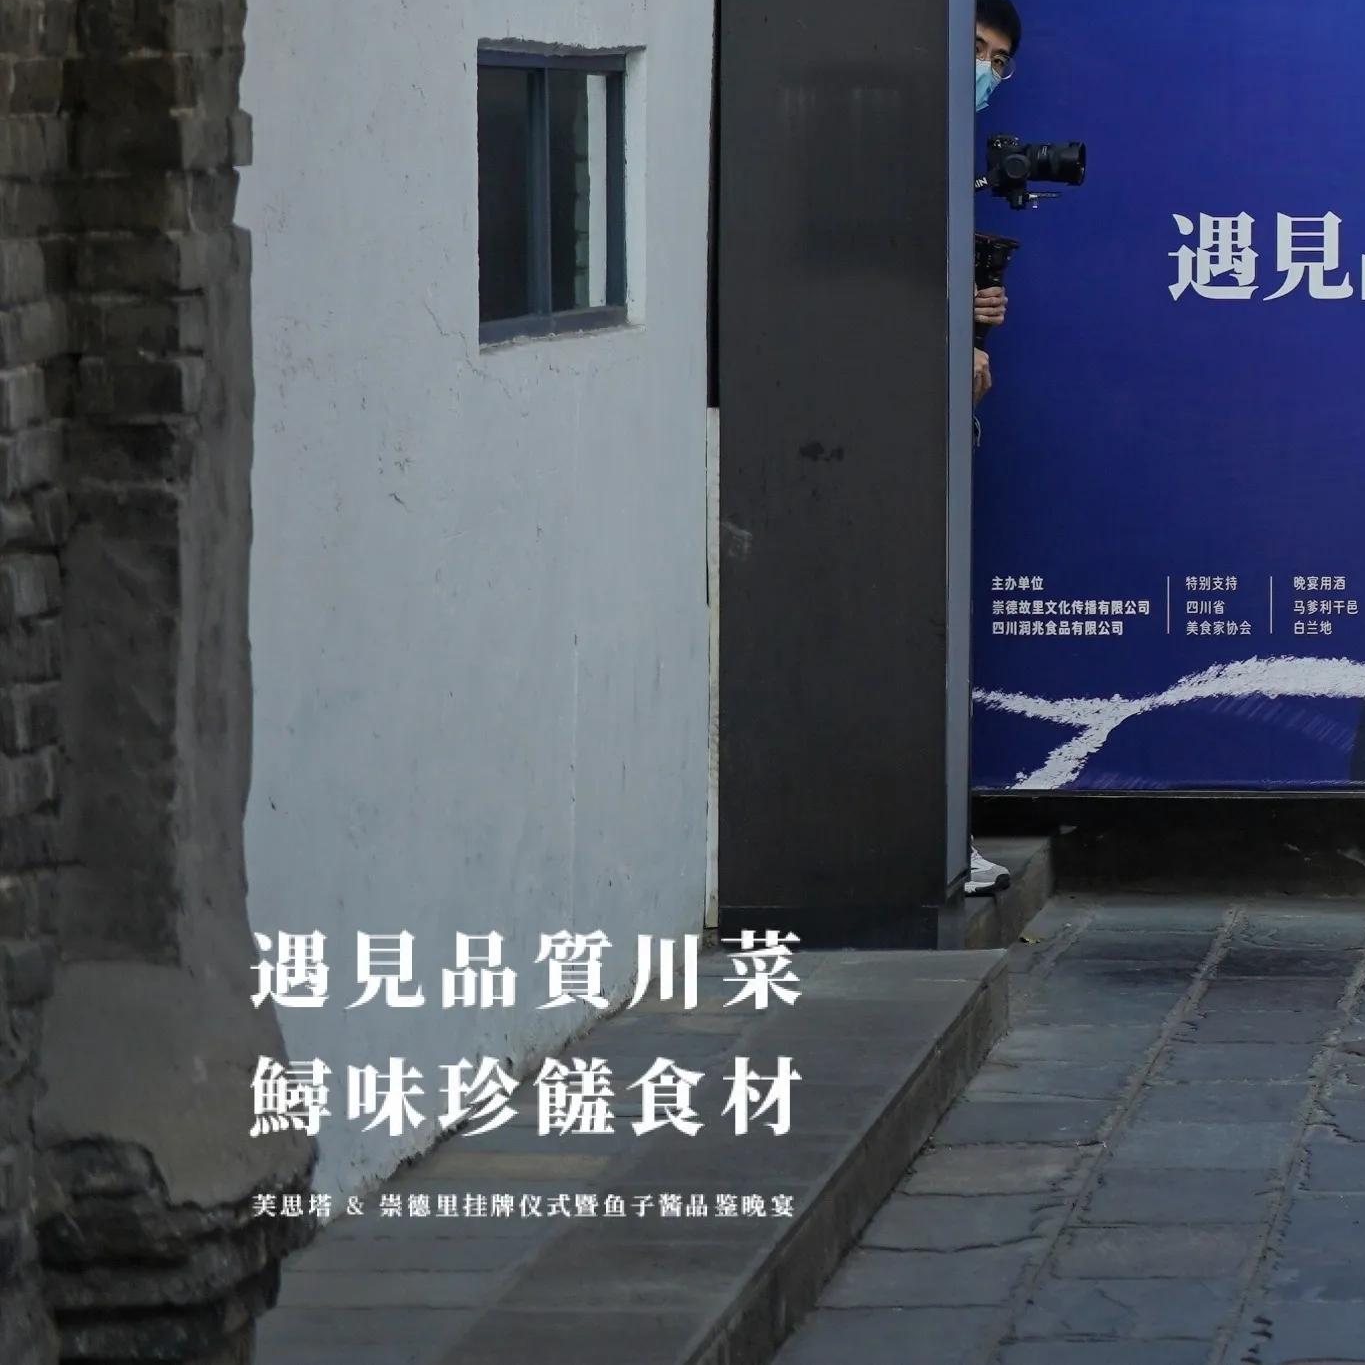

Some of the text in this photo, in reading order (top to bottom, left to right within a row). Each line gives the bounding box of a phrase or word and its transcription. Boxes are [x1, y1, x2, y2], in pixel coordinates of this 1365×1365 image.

[991, 575, 1044, 591] 主办单位
[1185, 575, 1238, 591] 特别支持
[1293, 575, 1346, 591] 晚宴用酒
[992, 599, 1150, 616] 崇德故里文化传播有限公司
[1186, 599, 1225, 615] 四川省
[1293, 599, 1359, 615] 马爹利干邑
[992, 620, 1123, 636] 四川润兆食品有限公司
[1186, 620, 1252, 636] 美食家协会
[1294, 620, 1333, 636] 白兰地
